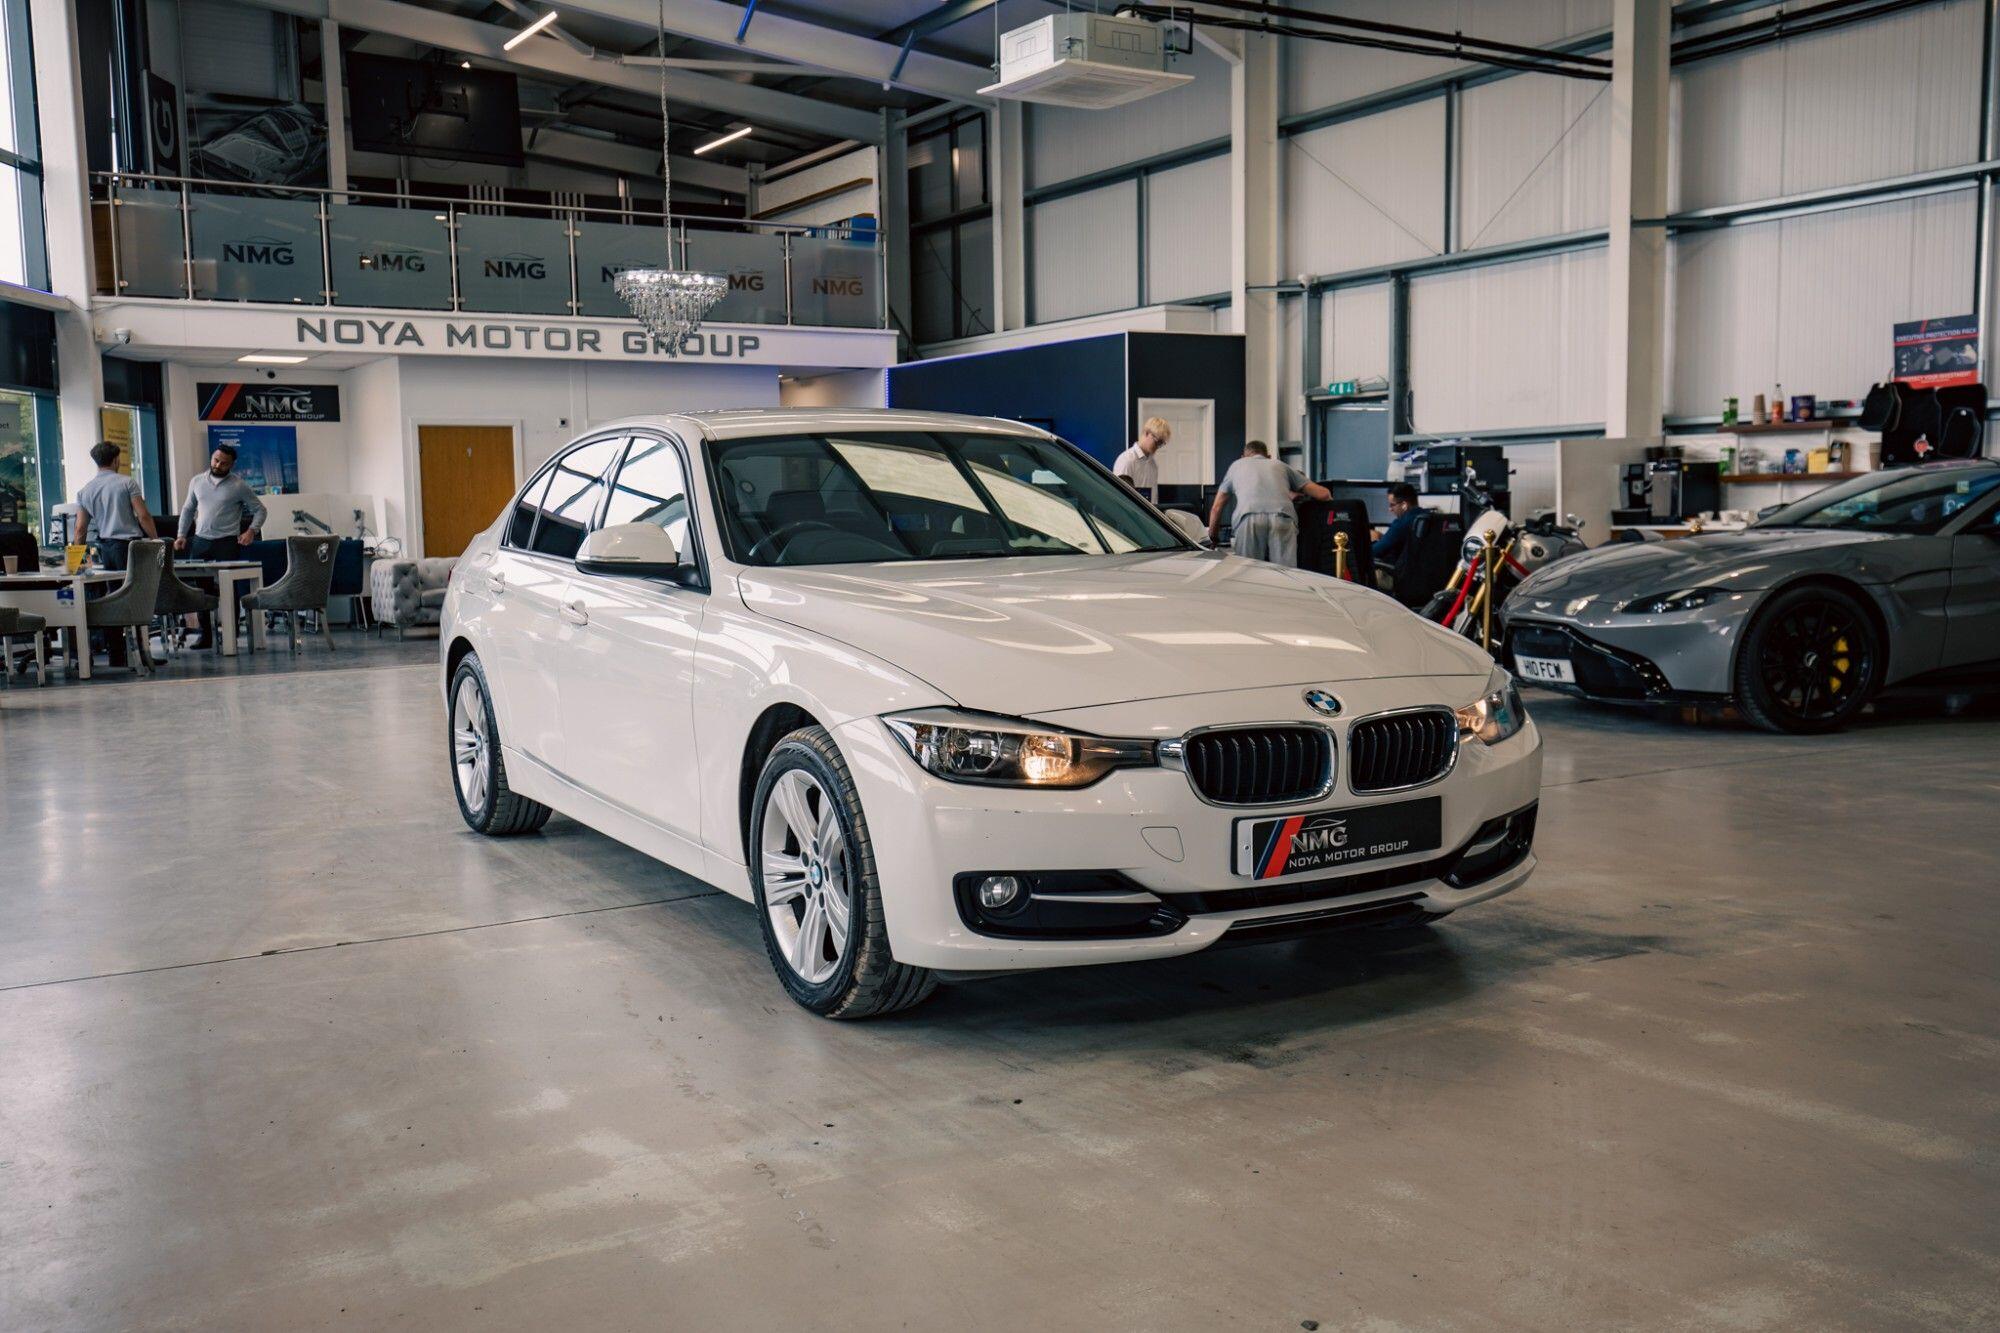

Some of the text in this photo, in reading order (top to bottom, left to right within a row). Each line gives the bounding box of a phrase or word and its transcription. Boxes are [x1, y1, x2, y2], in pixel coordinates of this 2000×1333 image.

[222, 244, 295, 265] NMG
[359, 254, 425, 272] NMG
[484, 261, 546, 279] NMG
[728, 274, 764, 291] MG
[812, 279, 864, 296] NMG
[297, 317, 424, 347] NOYA
[446, 323, 601, 353] MOTOR
[245, 395, 314, 413] NMG
[1289, 826, 1348, 854] NMG
[1289, 840, 1409, 868] NOYA MOTOR GROUP
